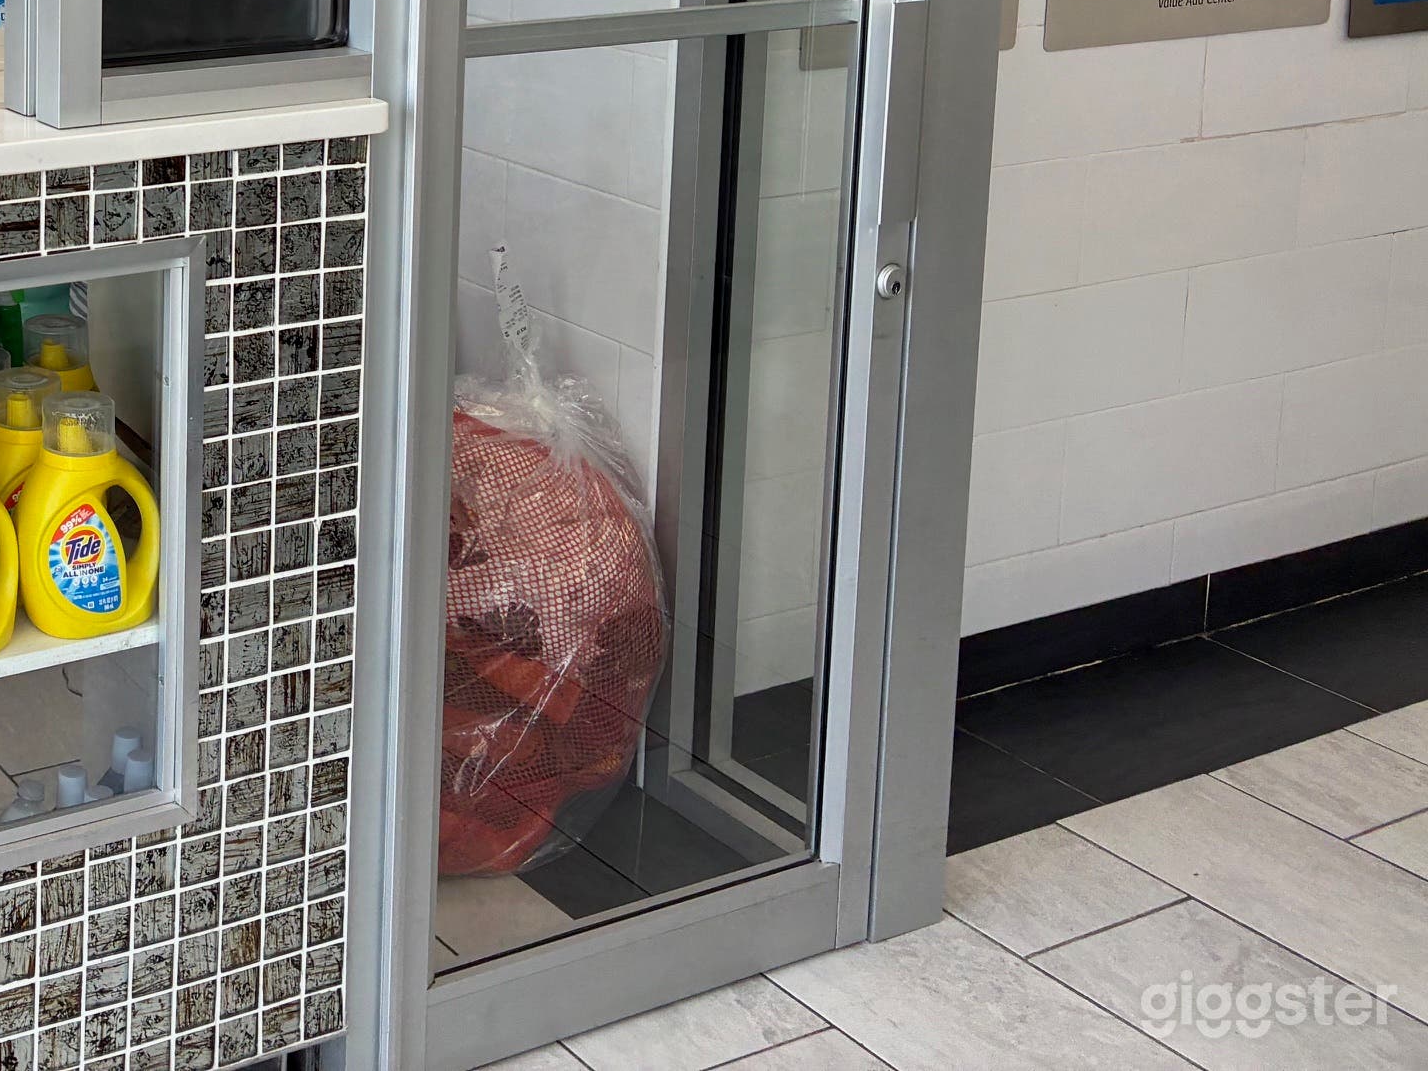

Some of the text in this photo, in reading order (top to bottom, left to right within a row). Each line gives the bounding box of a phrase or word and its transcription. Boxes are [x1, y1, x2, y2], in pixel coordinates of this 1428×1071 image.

[61, 515, 82, 533] 99%
[65, 535, 101, 566] Tide
[63, 570, 79, 579] ALL
[88, 566, 105, 575] ONE
[72, 562, 96, 571] SIMPLY
